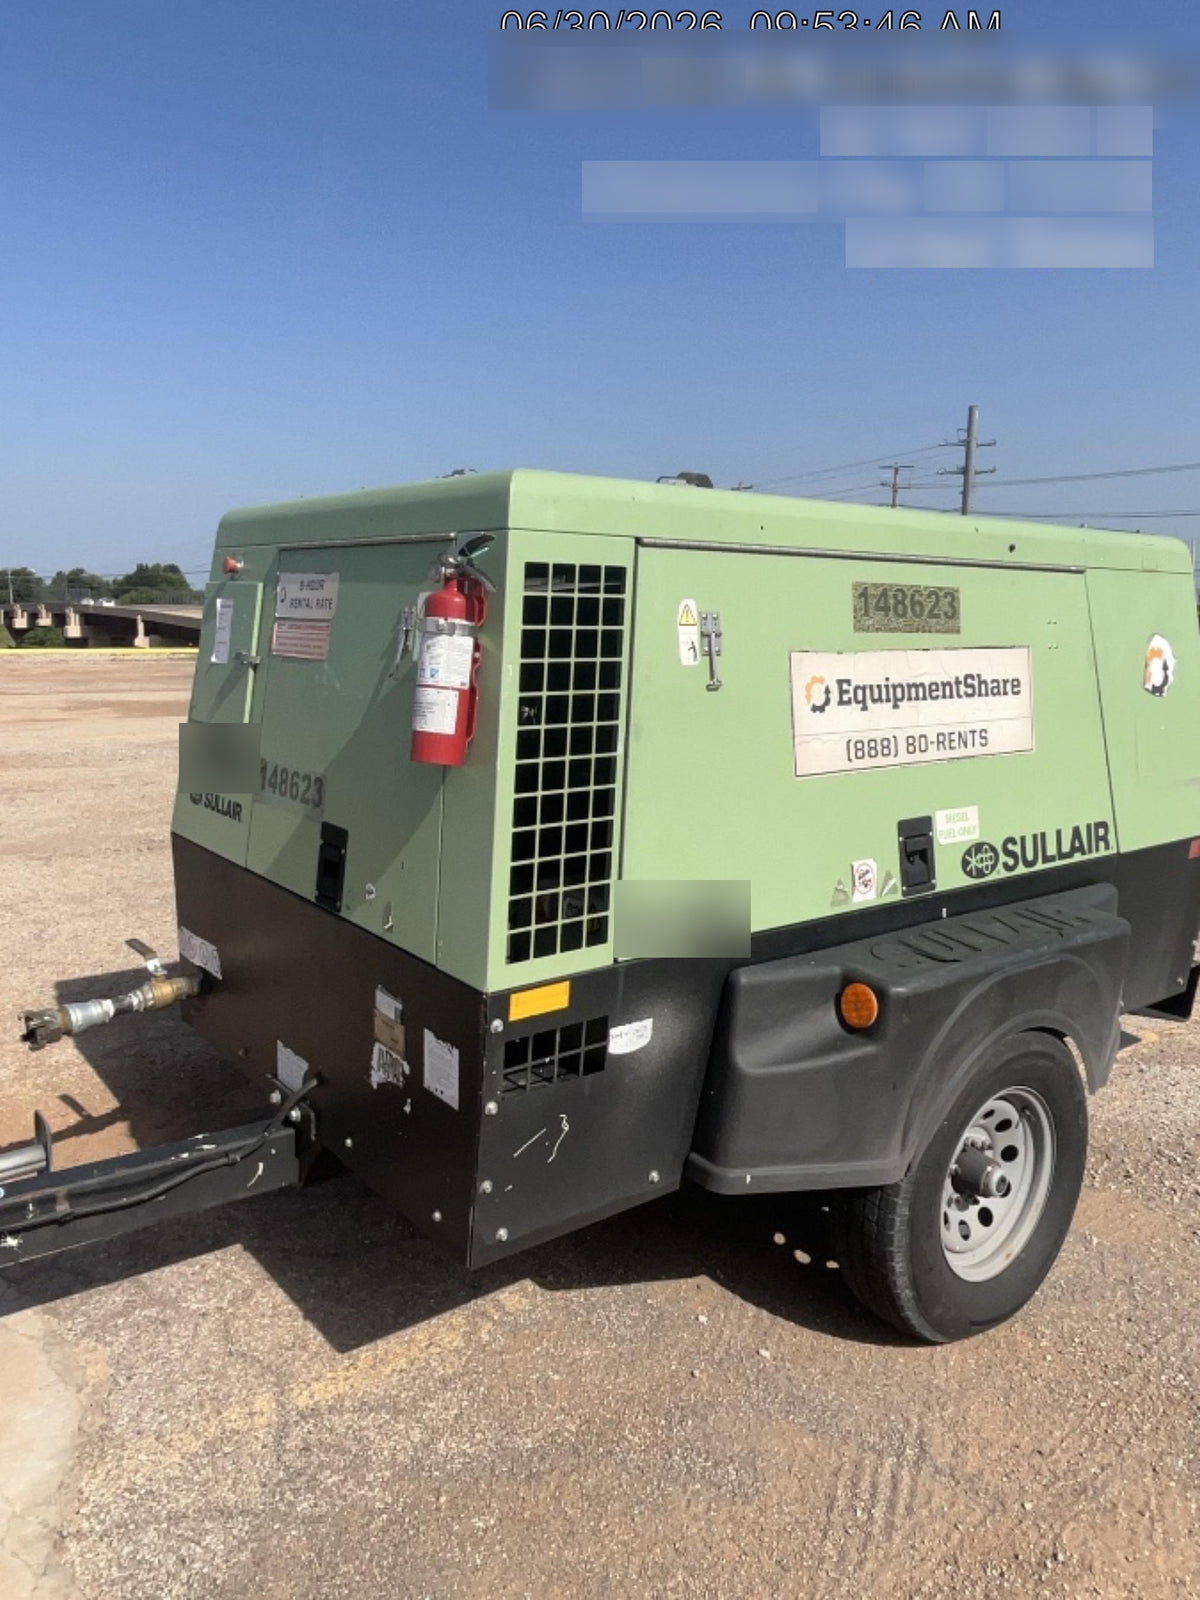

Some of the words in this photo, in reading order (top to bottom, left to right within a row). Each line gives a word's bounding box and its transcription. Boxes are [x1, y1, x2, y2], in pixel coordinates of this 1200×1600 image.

[858, 586, 958, 620] 148623
[836, 673, 1021, 711] EquipmentShare
[846, 735, 899, 763] (888)
[906, 728, 989, 755] 80-RENTS
[260, 757, 325, 809] 148623
[1001, 820, 1111, 872] SULLAIR
